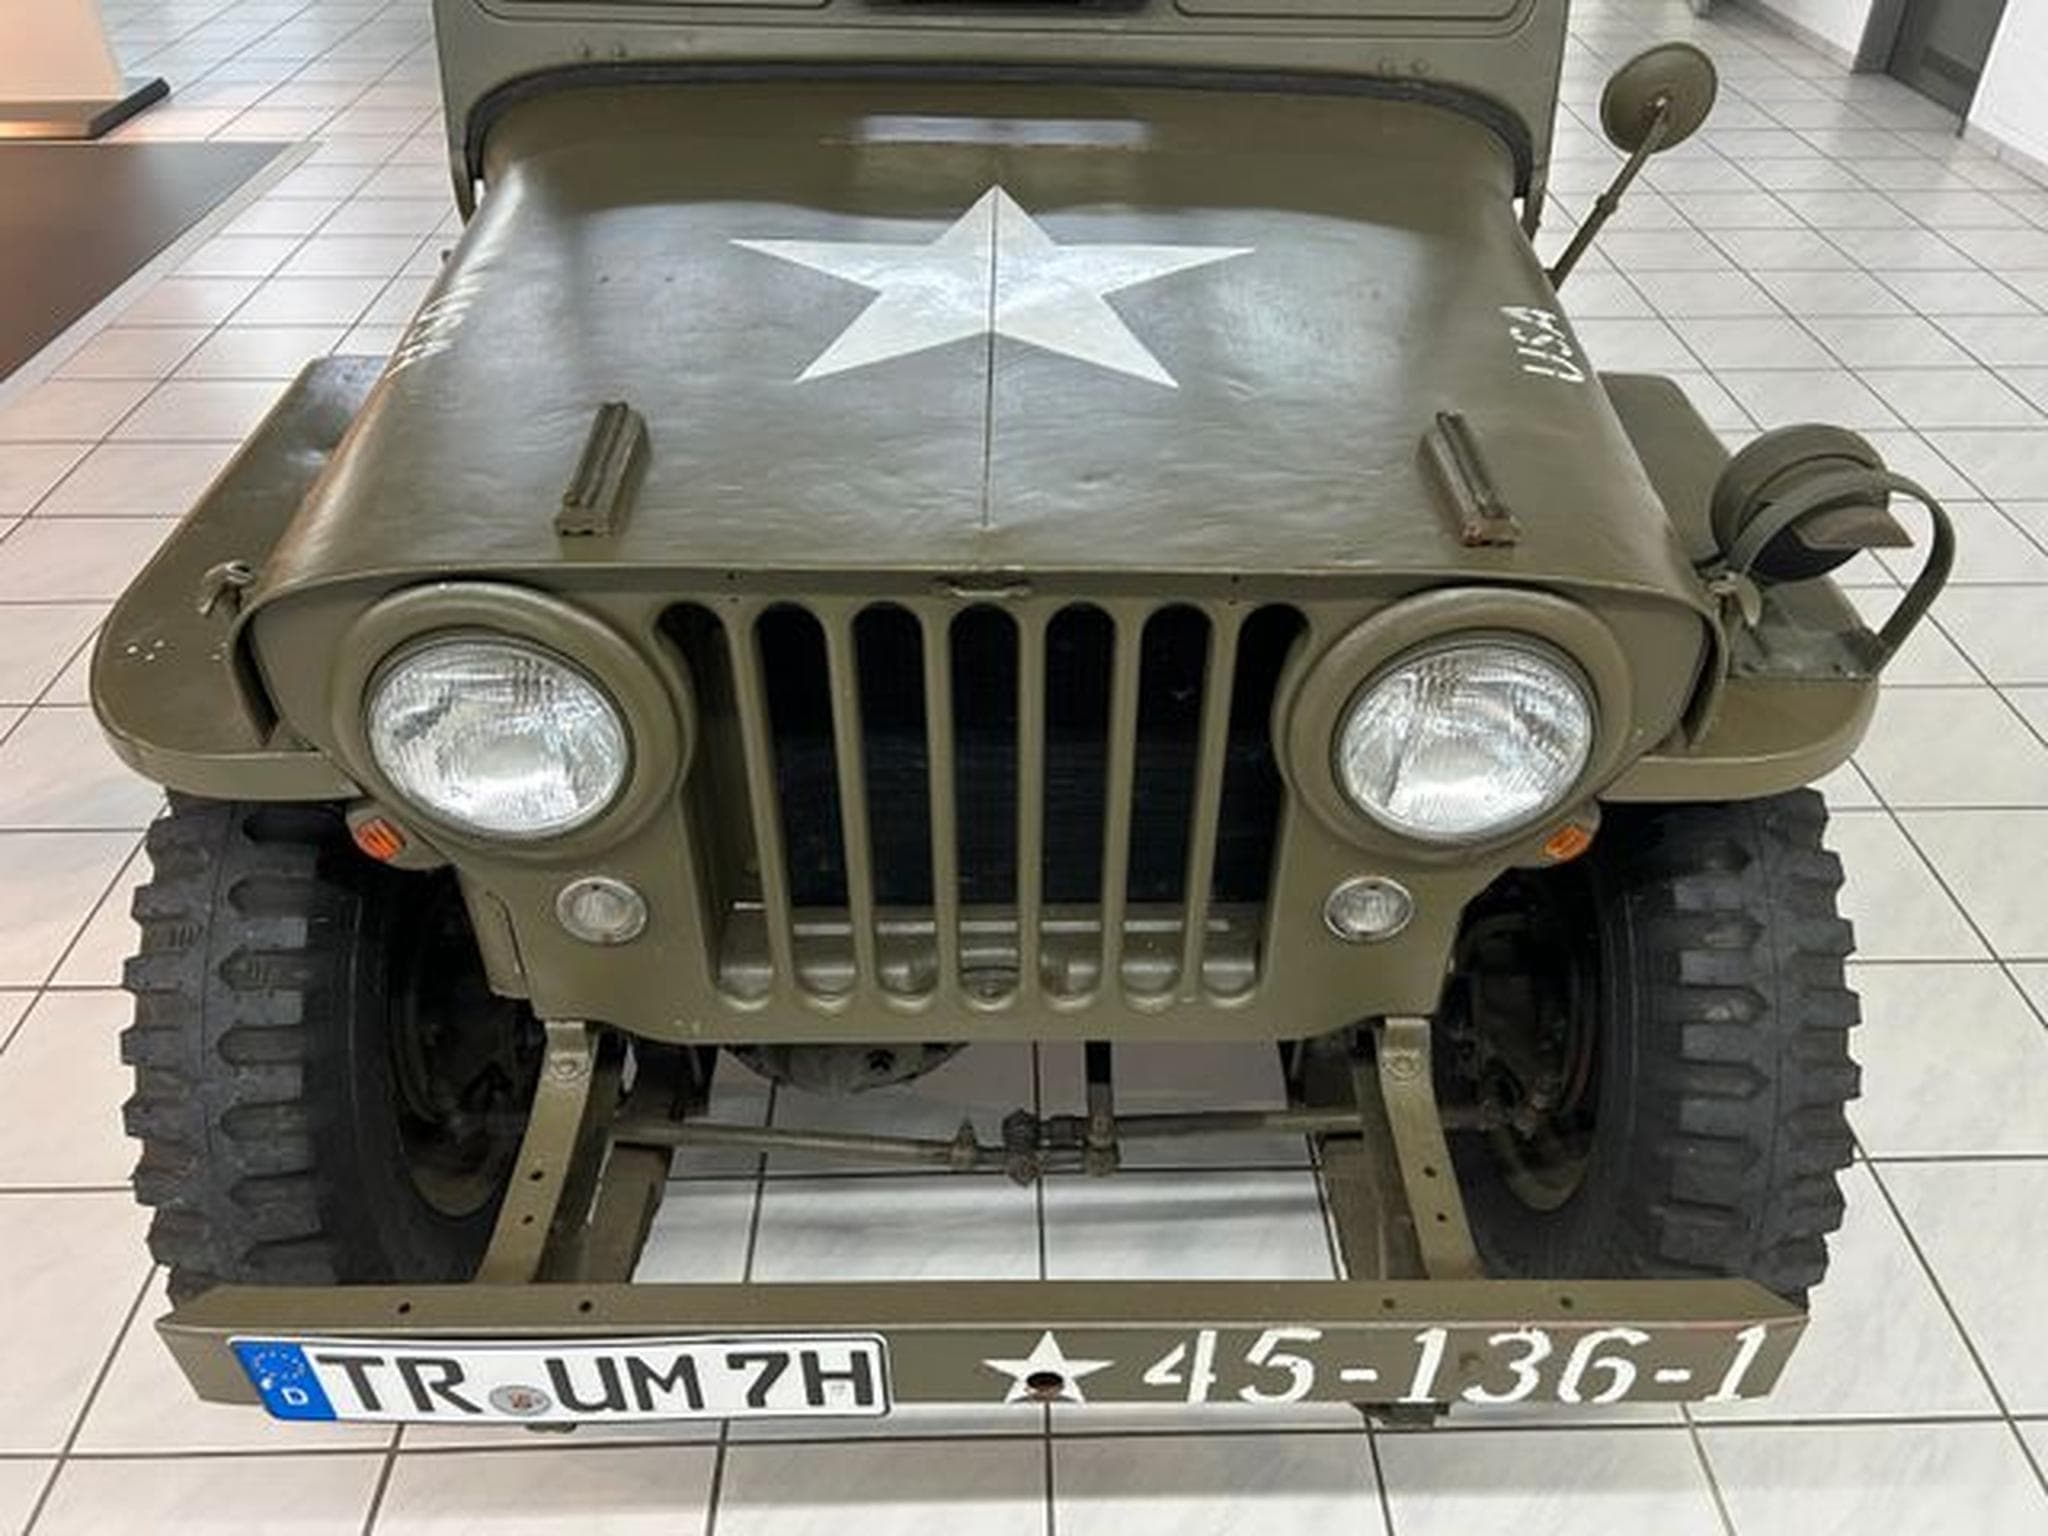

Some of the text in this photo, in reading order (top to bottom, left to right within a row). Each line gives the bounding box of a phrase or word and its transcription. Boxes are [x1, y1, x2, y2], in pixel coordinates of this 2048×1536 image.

[1500, 306, 1584, 382] USA
[281, 1387, 309, 1406] D
[314, 1349, 875, 1413] TR UM 7H
[1143, 1325, 1767, 1404] 45-136-1
